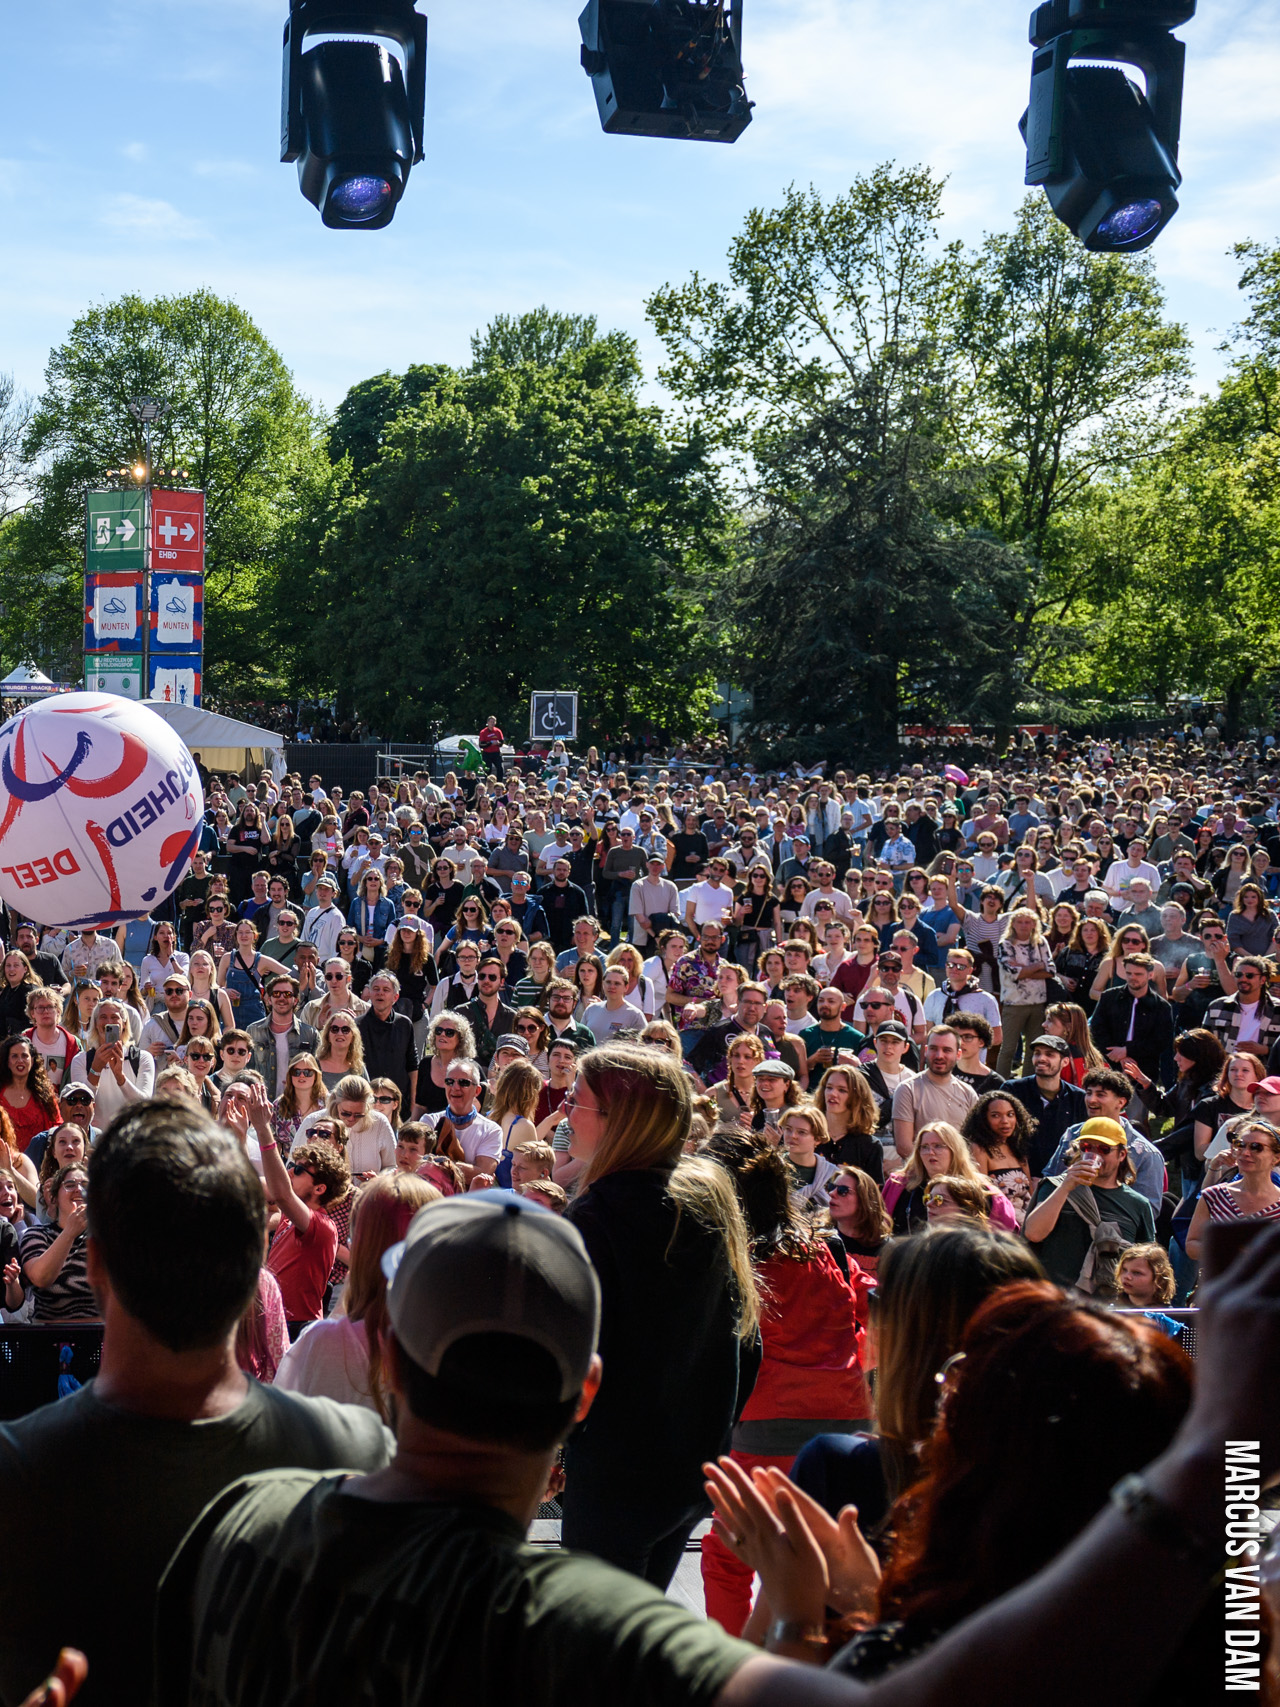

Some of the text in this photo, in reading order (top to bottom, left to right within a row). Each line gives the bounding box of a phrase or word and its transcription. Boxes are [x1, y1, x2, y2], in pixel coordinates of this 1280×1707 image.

[158, 551, 177, 560] EHBO
[100, 622, 130, 631] MUNTEN
[163, 621, 190, 630] MUNTEN
[1, 848, 81, 889] DEEL
